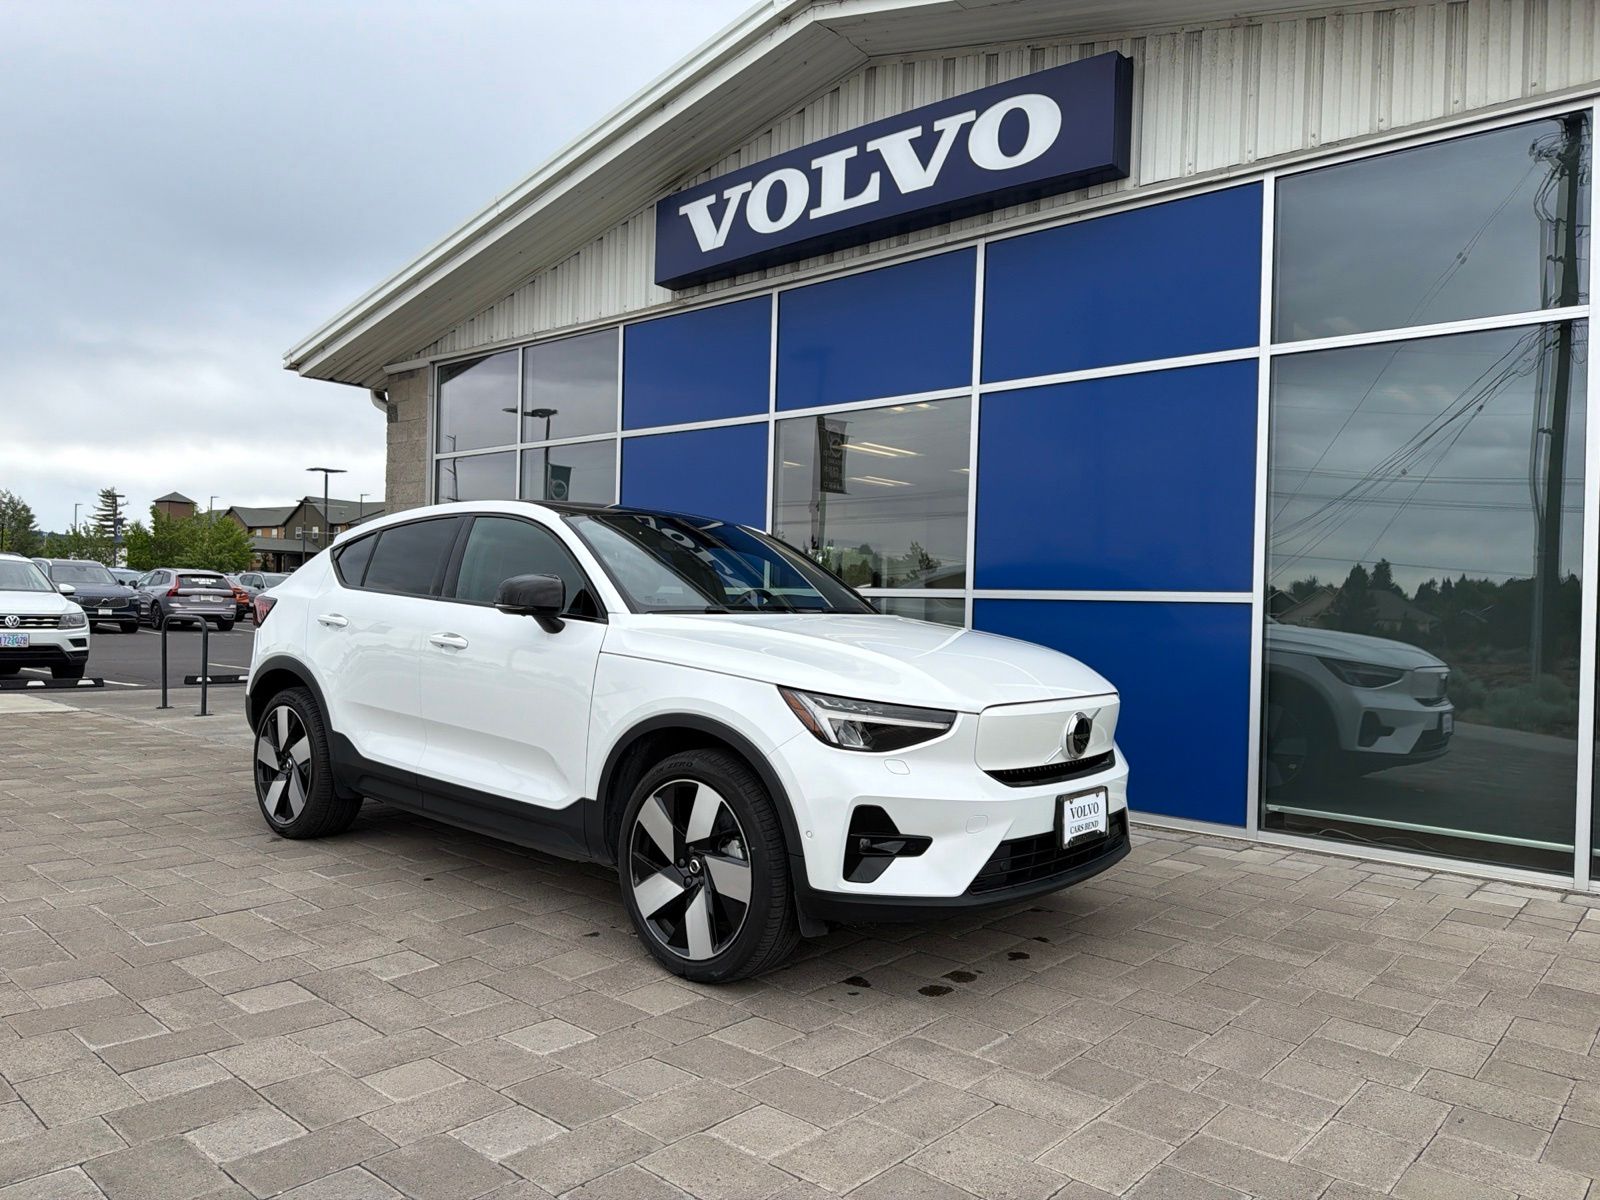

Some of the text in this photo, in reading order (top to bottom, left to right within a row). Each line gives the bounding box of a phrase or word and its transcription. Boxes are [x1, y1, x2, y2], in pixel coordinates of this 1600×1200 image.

[679, 93, 1063, 254] VOLVO
[1070, 802, 1099, 820] VOLVO
[1070, 820, 1099, 835] CARS BEND
